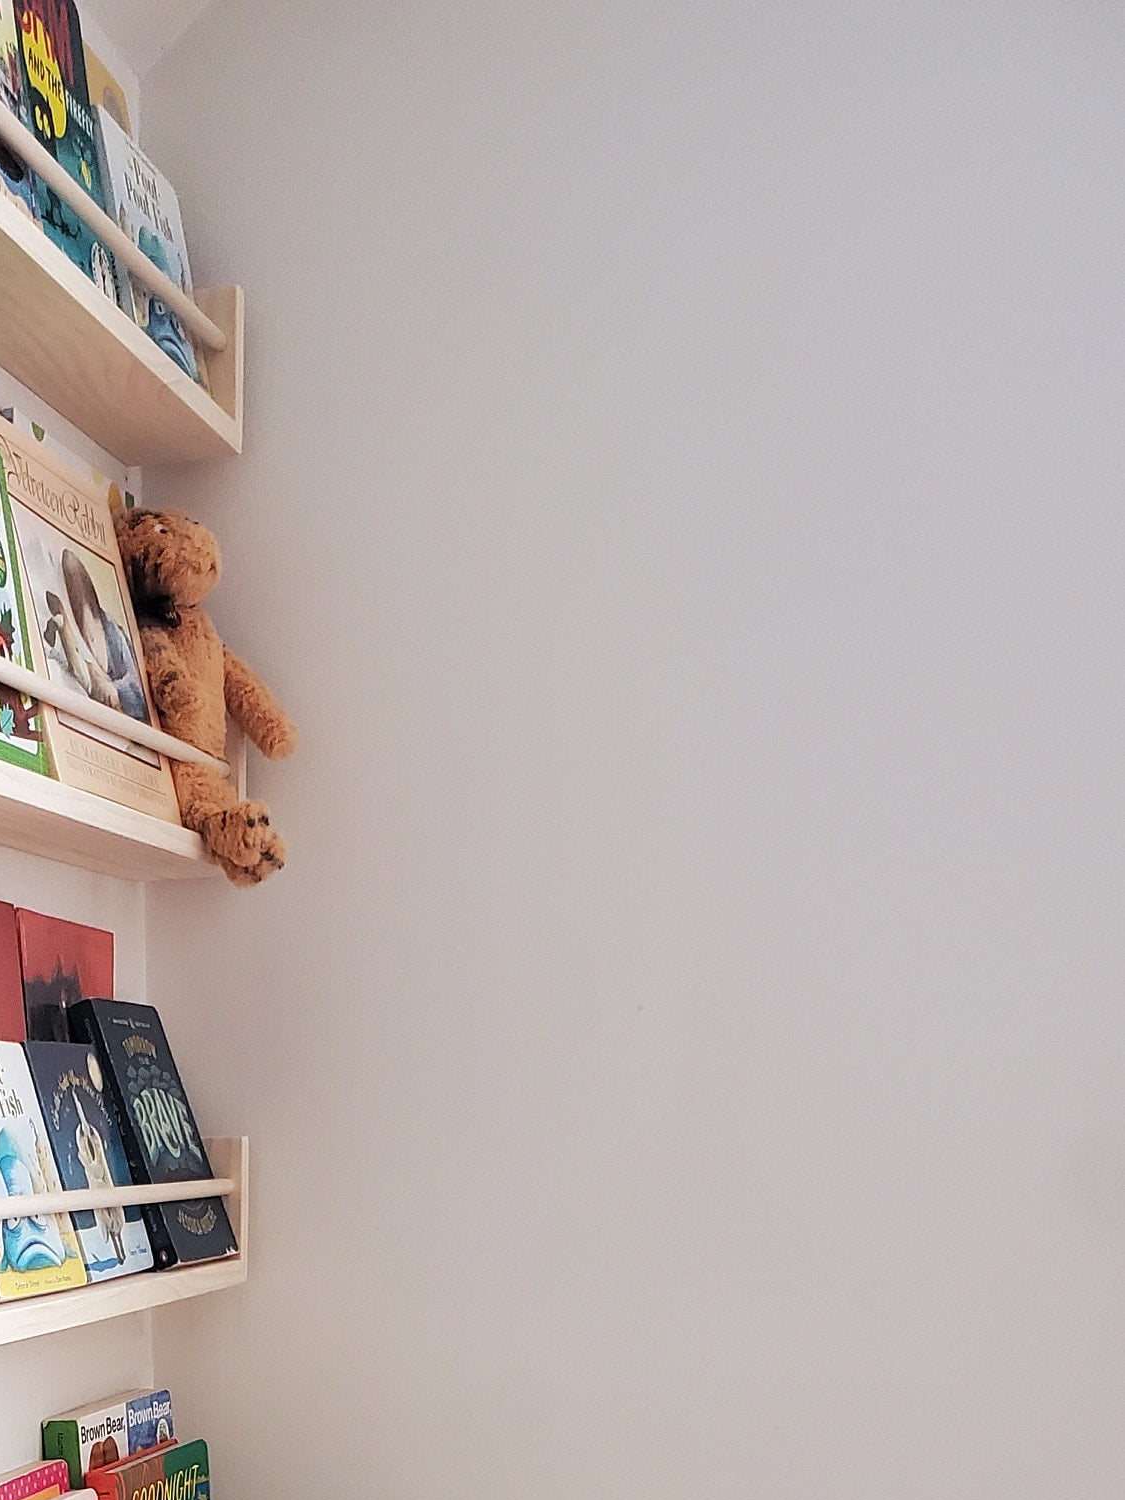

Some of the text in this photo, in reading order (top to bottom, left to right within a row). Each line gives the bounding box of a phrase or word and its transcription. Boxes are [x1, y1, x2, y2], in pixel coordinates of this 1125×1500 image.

[27, 47, 63, 105] AND THE
[65, 90, 94, 140] FIREFLY
[132, 1087, 203, 1167] BRAVE
[80, 1422, 106, 1445] Brown
[106, 1416, 126, 1435] Bear,
[128, 1401, 172, 1428] Brown Bear,
